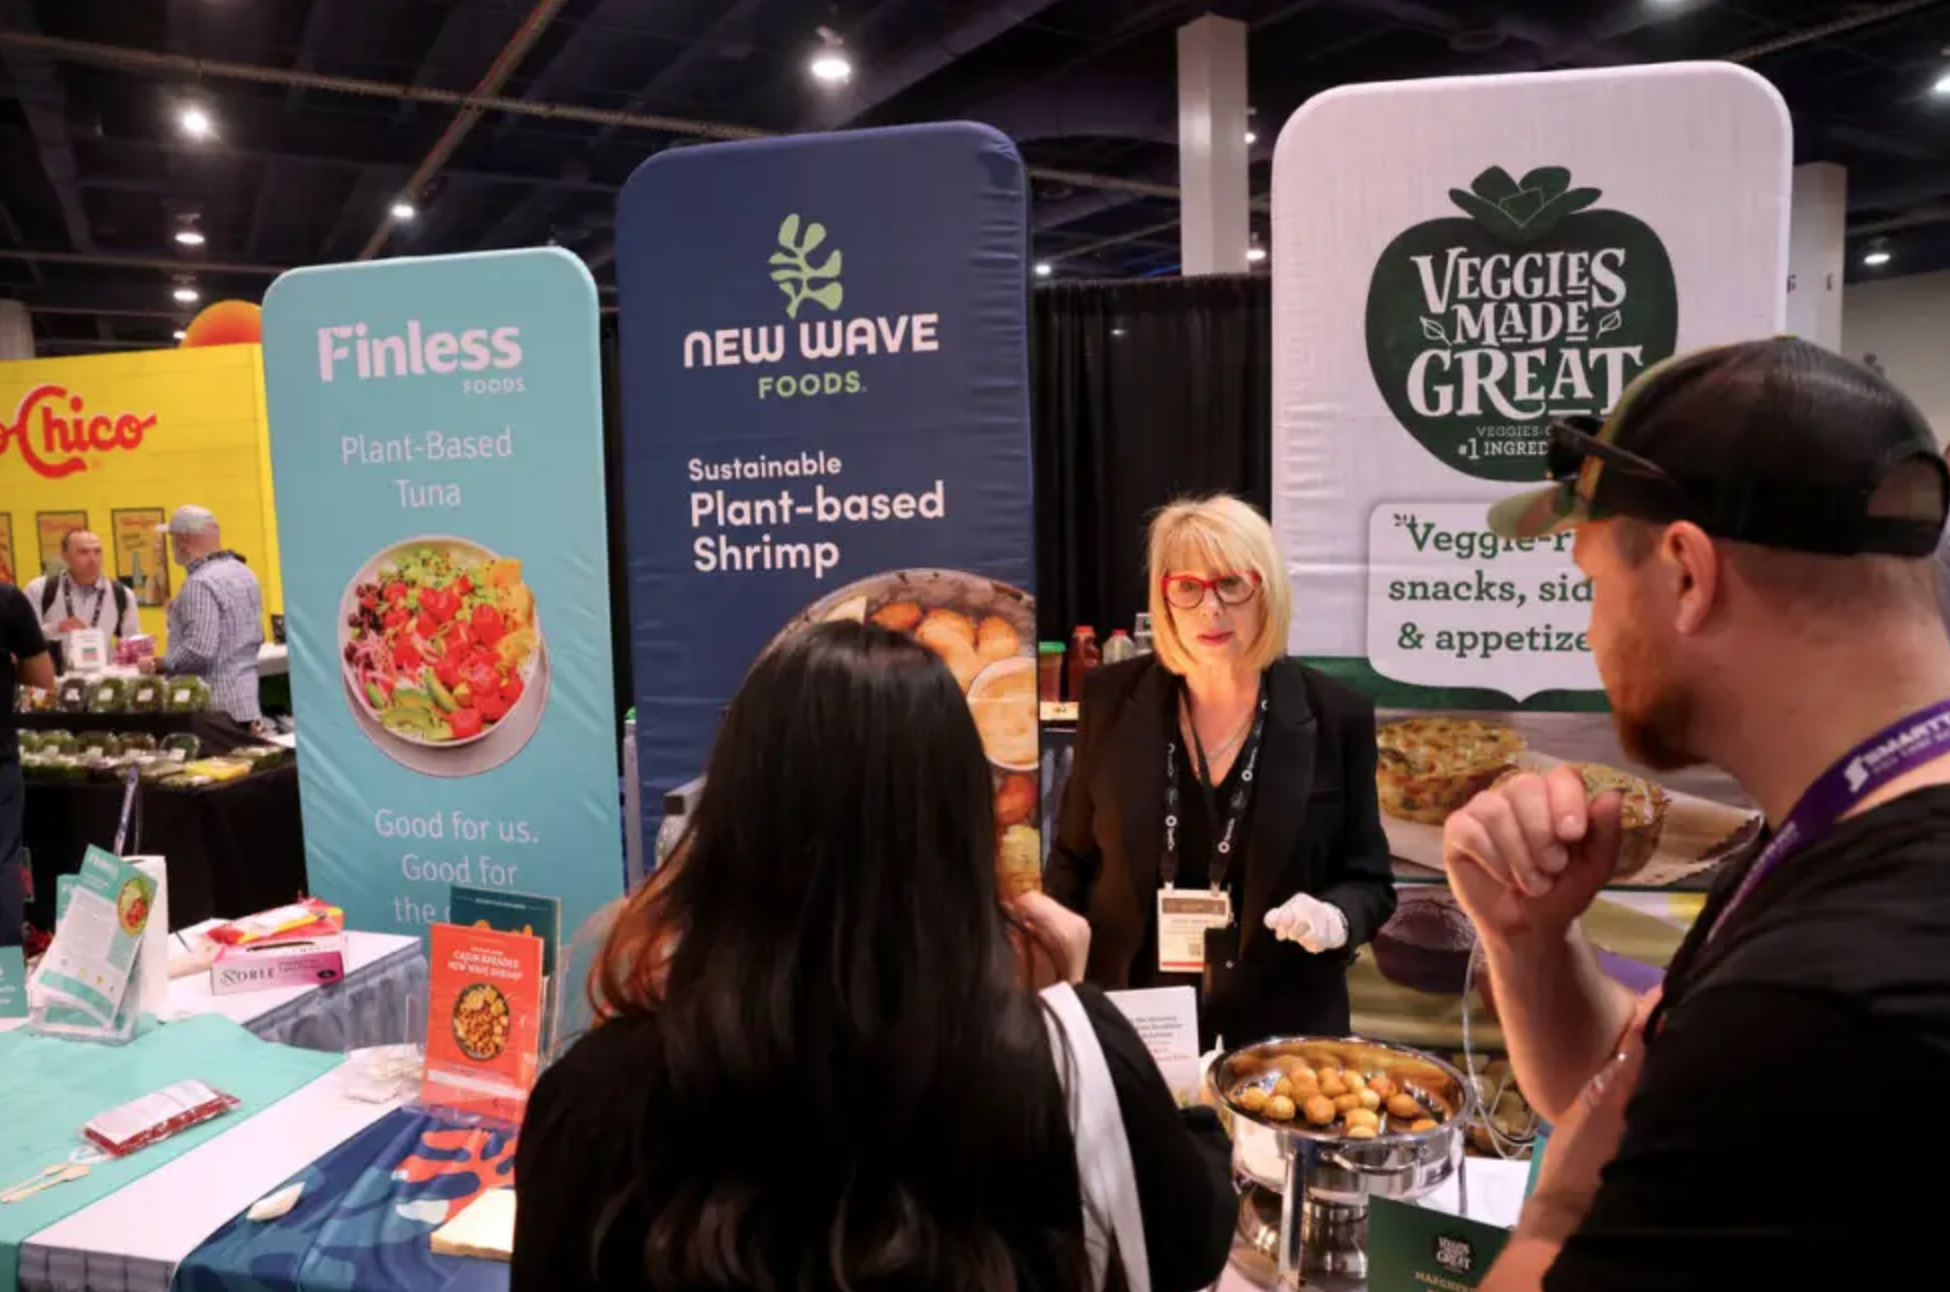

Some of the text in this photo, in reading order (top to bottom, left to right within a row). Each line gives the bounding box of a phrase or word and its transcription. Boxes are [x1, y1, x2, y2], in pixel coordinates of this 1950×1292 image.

[1410, 246, 1627, 315] VEGGIES
[684, 313, 940, 368] NEW WAVE
[1451, 301, 1590, 347] MADE
[317, 319, 523, 383] Finless
[463, 376, 526, 395] FOODS
[1407, 345, 1644, 420] GREAT
[13, 384, 157, 479] Chico
[341, 424, 513, 466] Plant-Based
[1458, 437, 1481, 460] #1
[688, 450, 843, 482] Sustainable
[394, 478, 462, 509] Tuna
[690, 479, 946, 528] Plant-based
[692, 533, 841, 580] Shrimp
[1388, 569, 1526, 608] snacks,
[1397, 621, 1424, 650] &
[374, 808, 539, 845] Good for us.
[402, 853, 518, 886] Good for
[394, 896, 435, 924] the
